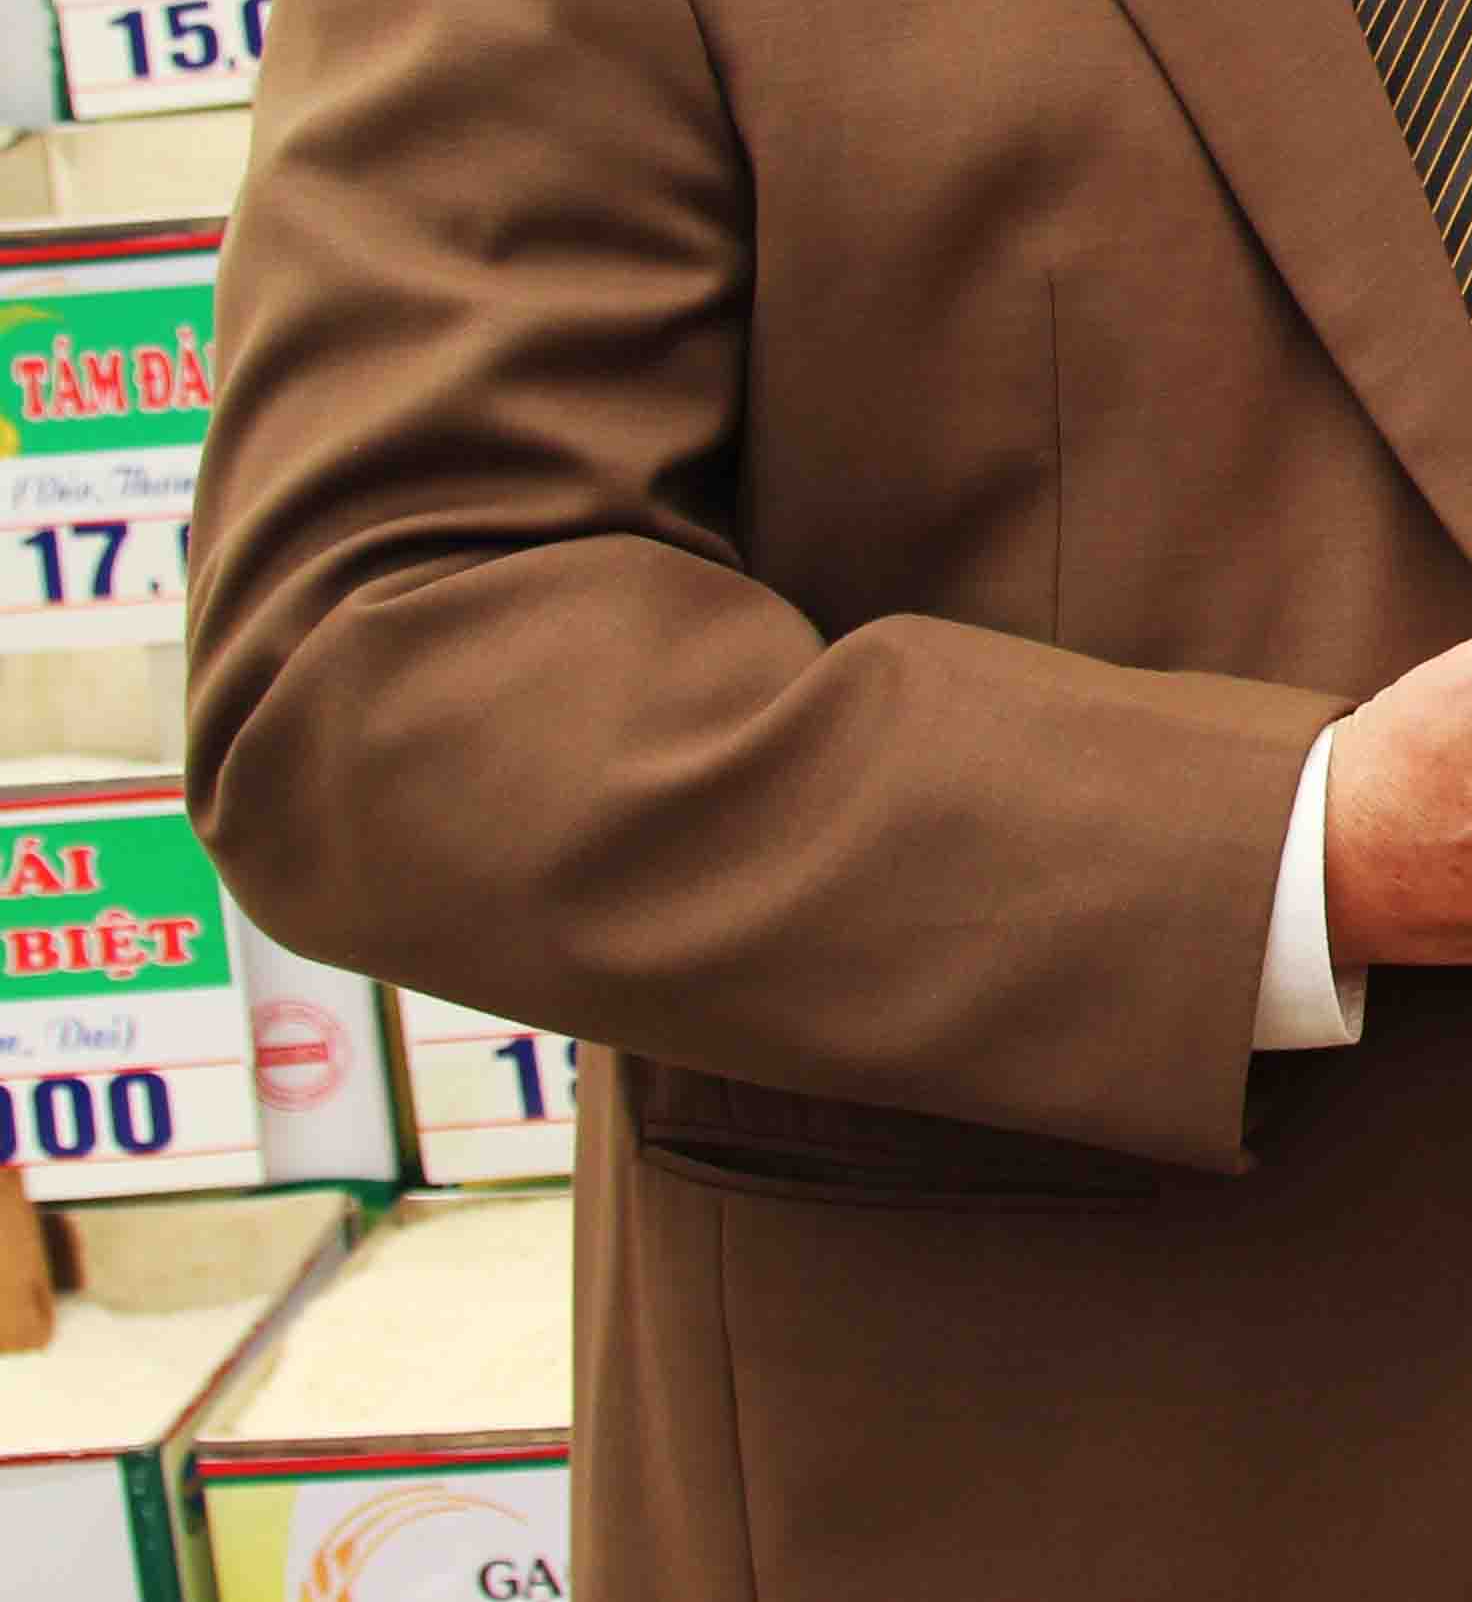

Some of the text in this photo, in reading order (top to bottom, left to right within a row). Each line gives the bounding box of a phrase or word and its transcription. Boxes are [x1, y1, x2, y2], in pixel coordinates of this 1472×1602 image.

[22, 520, 191, 605] 17.
[7, 909, 200, 980] BIỆT
[0, 1072, 173, 1161] 00
[494, 1037, 577, 1119] 1
